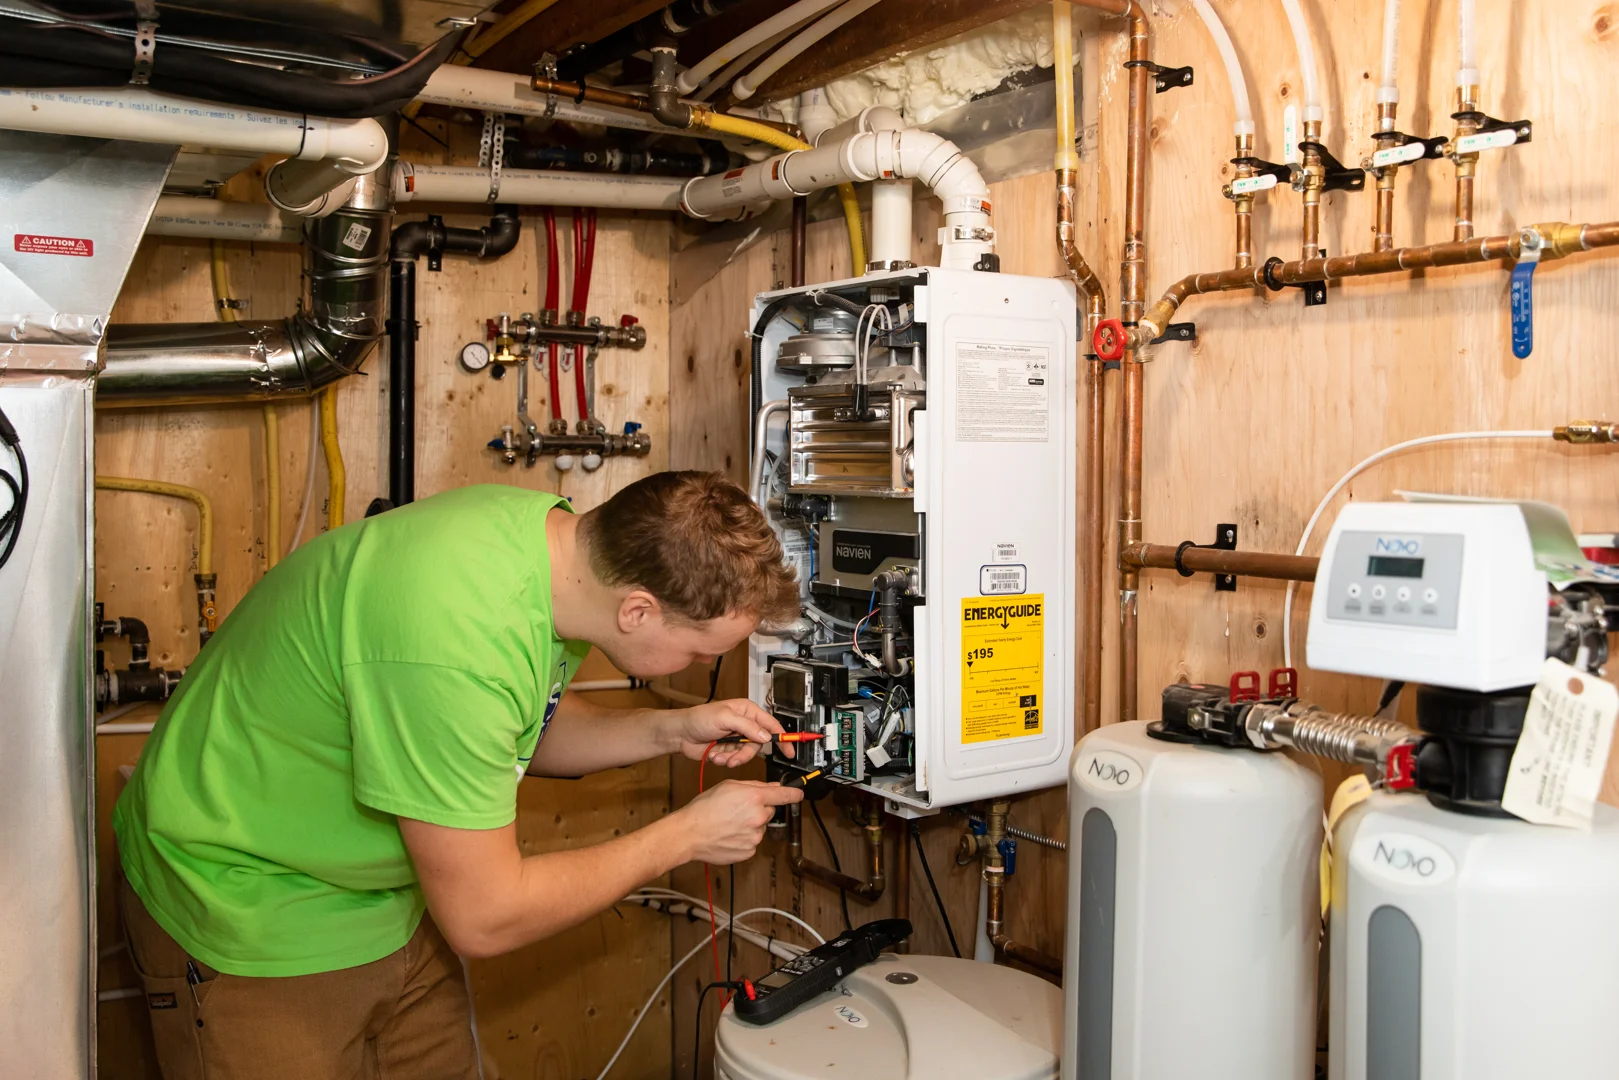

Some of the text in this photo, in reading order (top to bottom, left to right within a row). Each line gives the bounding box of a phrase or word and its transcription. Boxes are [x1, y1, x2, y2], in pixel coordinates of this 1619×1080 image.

[24, 89, 55, 101] Follow
[58, 93, 124, 109] Manufacturer's
[129, 101, 181, 115] installation
[184, 107, 236, 120] requirements
[247, 113, 272, 125] Suivez
[276, 117, 288, 126] les
[32, 237, 75, 247] CAUTION
[1375, 537, 1420, 555] NOVO
[964, 603, 1042, 622] ENERGYGUIDE
[967, 647, 994, 661] $195
[1088, 757, 1130, 786] NOVO
[1372, 839, 1437, 878] NOVO
